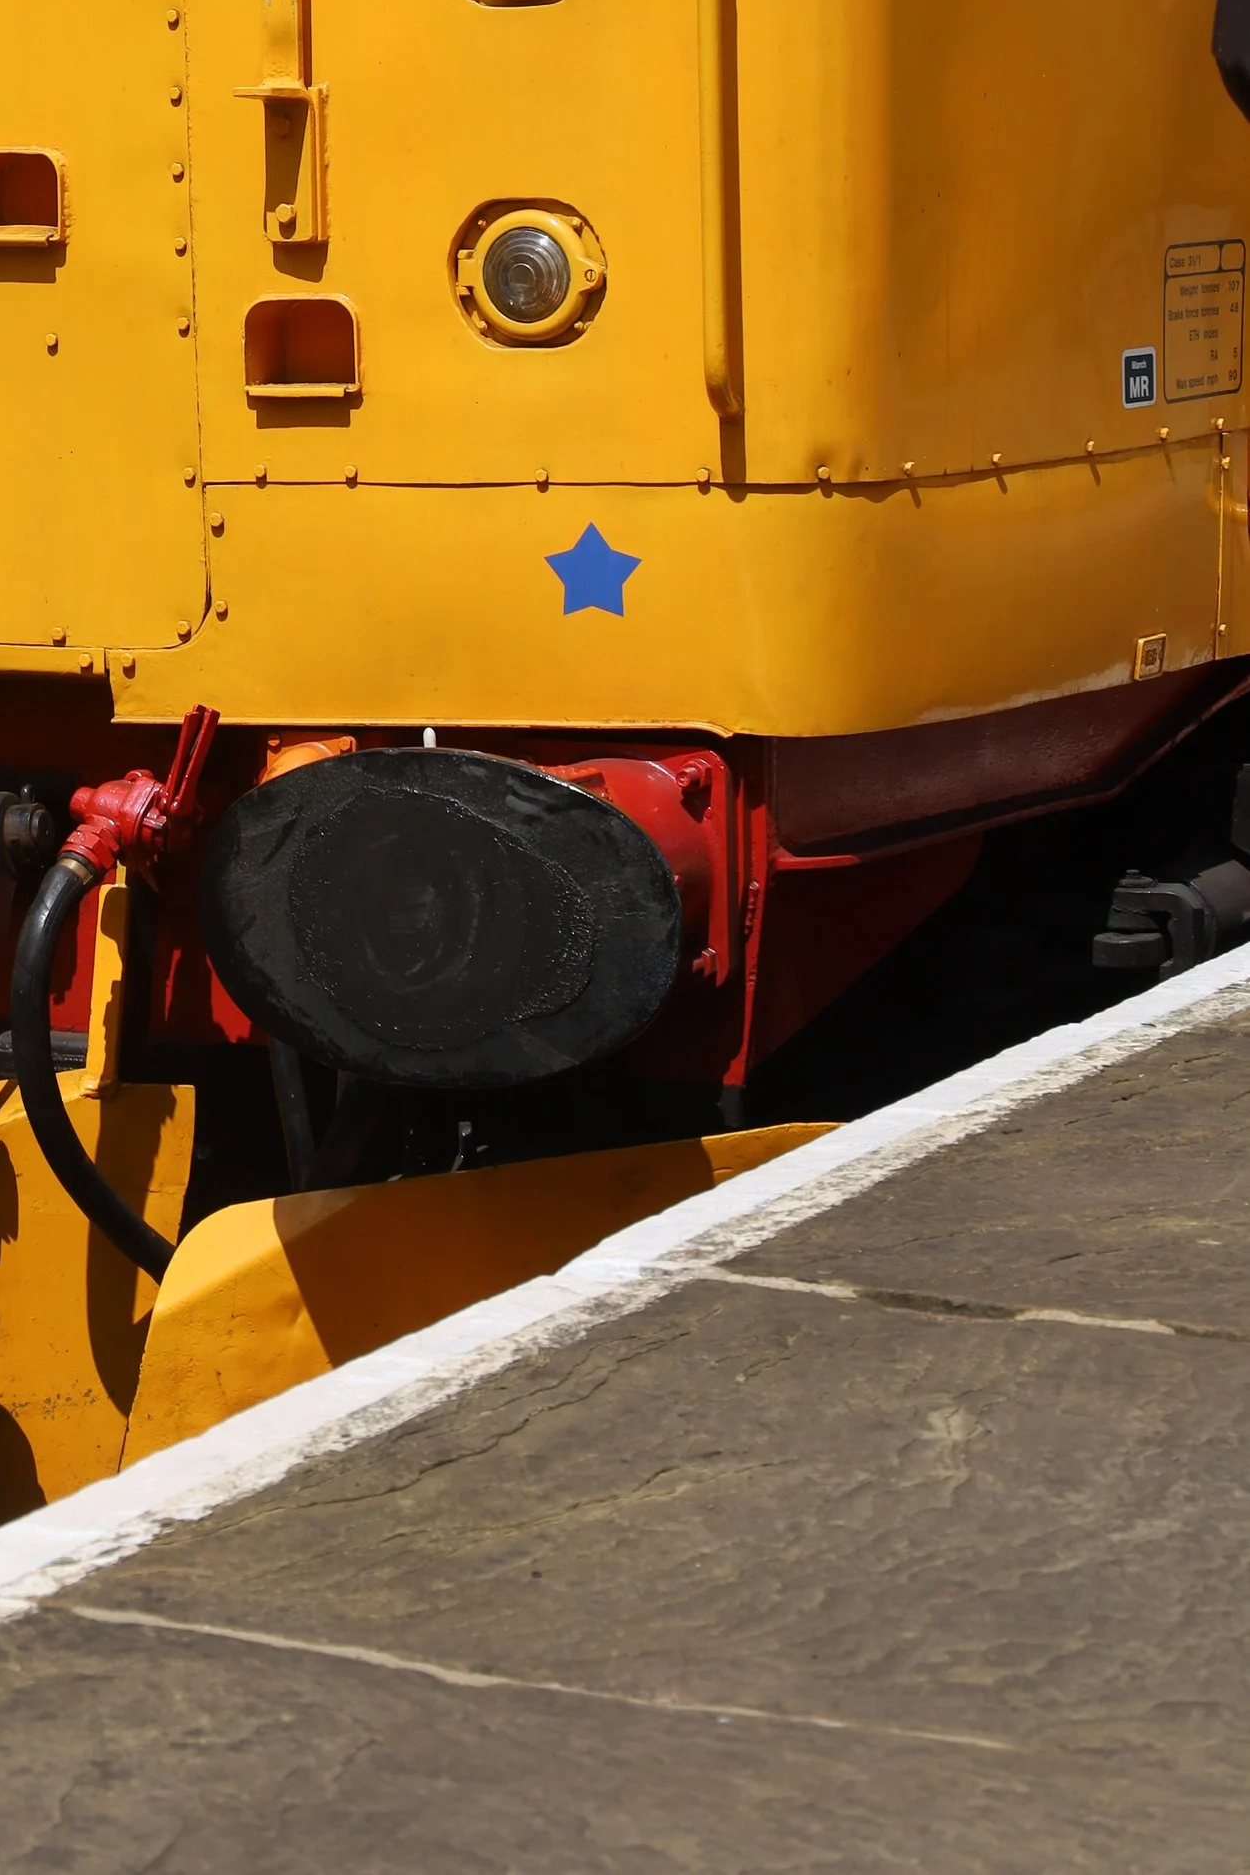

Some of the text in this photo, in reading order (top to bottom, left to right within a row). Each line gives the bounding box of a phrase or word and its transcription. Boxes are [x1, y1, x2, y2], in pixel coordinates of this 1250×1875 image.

[1170, 256, 1185, 268] Class
[1179, 284, 1198, 298] Weight
[1228, 280, 1240, 292] 107
[1168, 309, 1183, 321] Brake
[1233, 347, 1238, 358] 5
[1129, 375, 1150, 398] MR
[1176, 378, 1187, 390] Max
[1188, 376, 1204, 388] speed
[1228, 369, 1238, 381] 90
